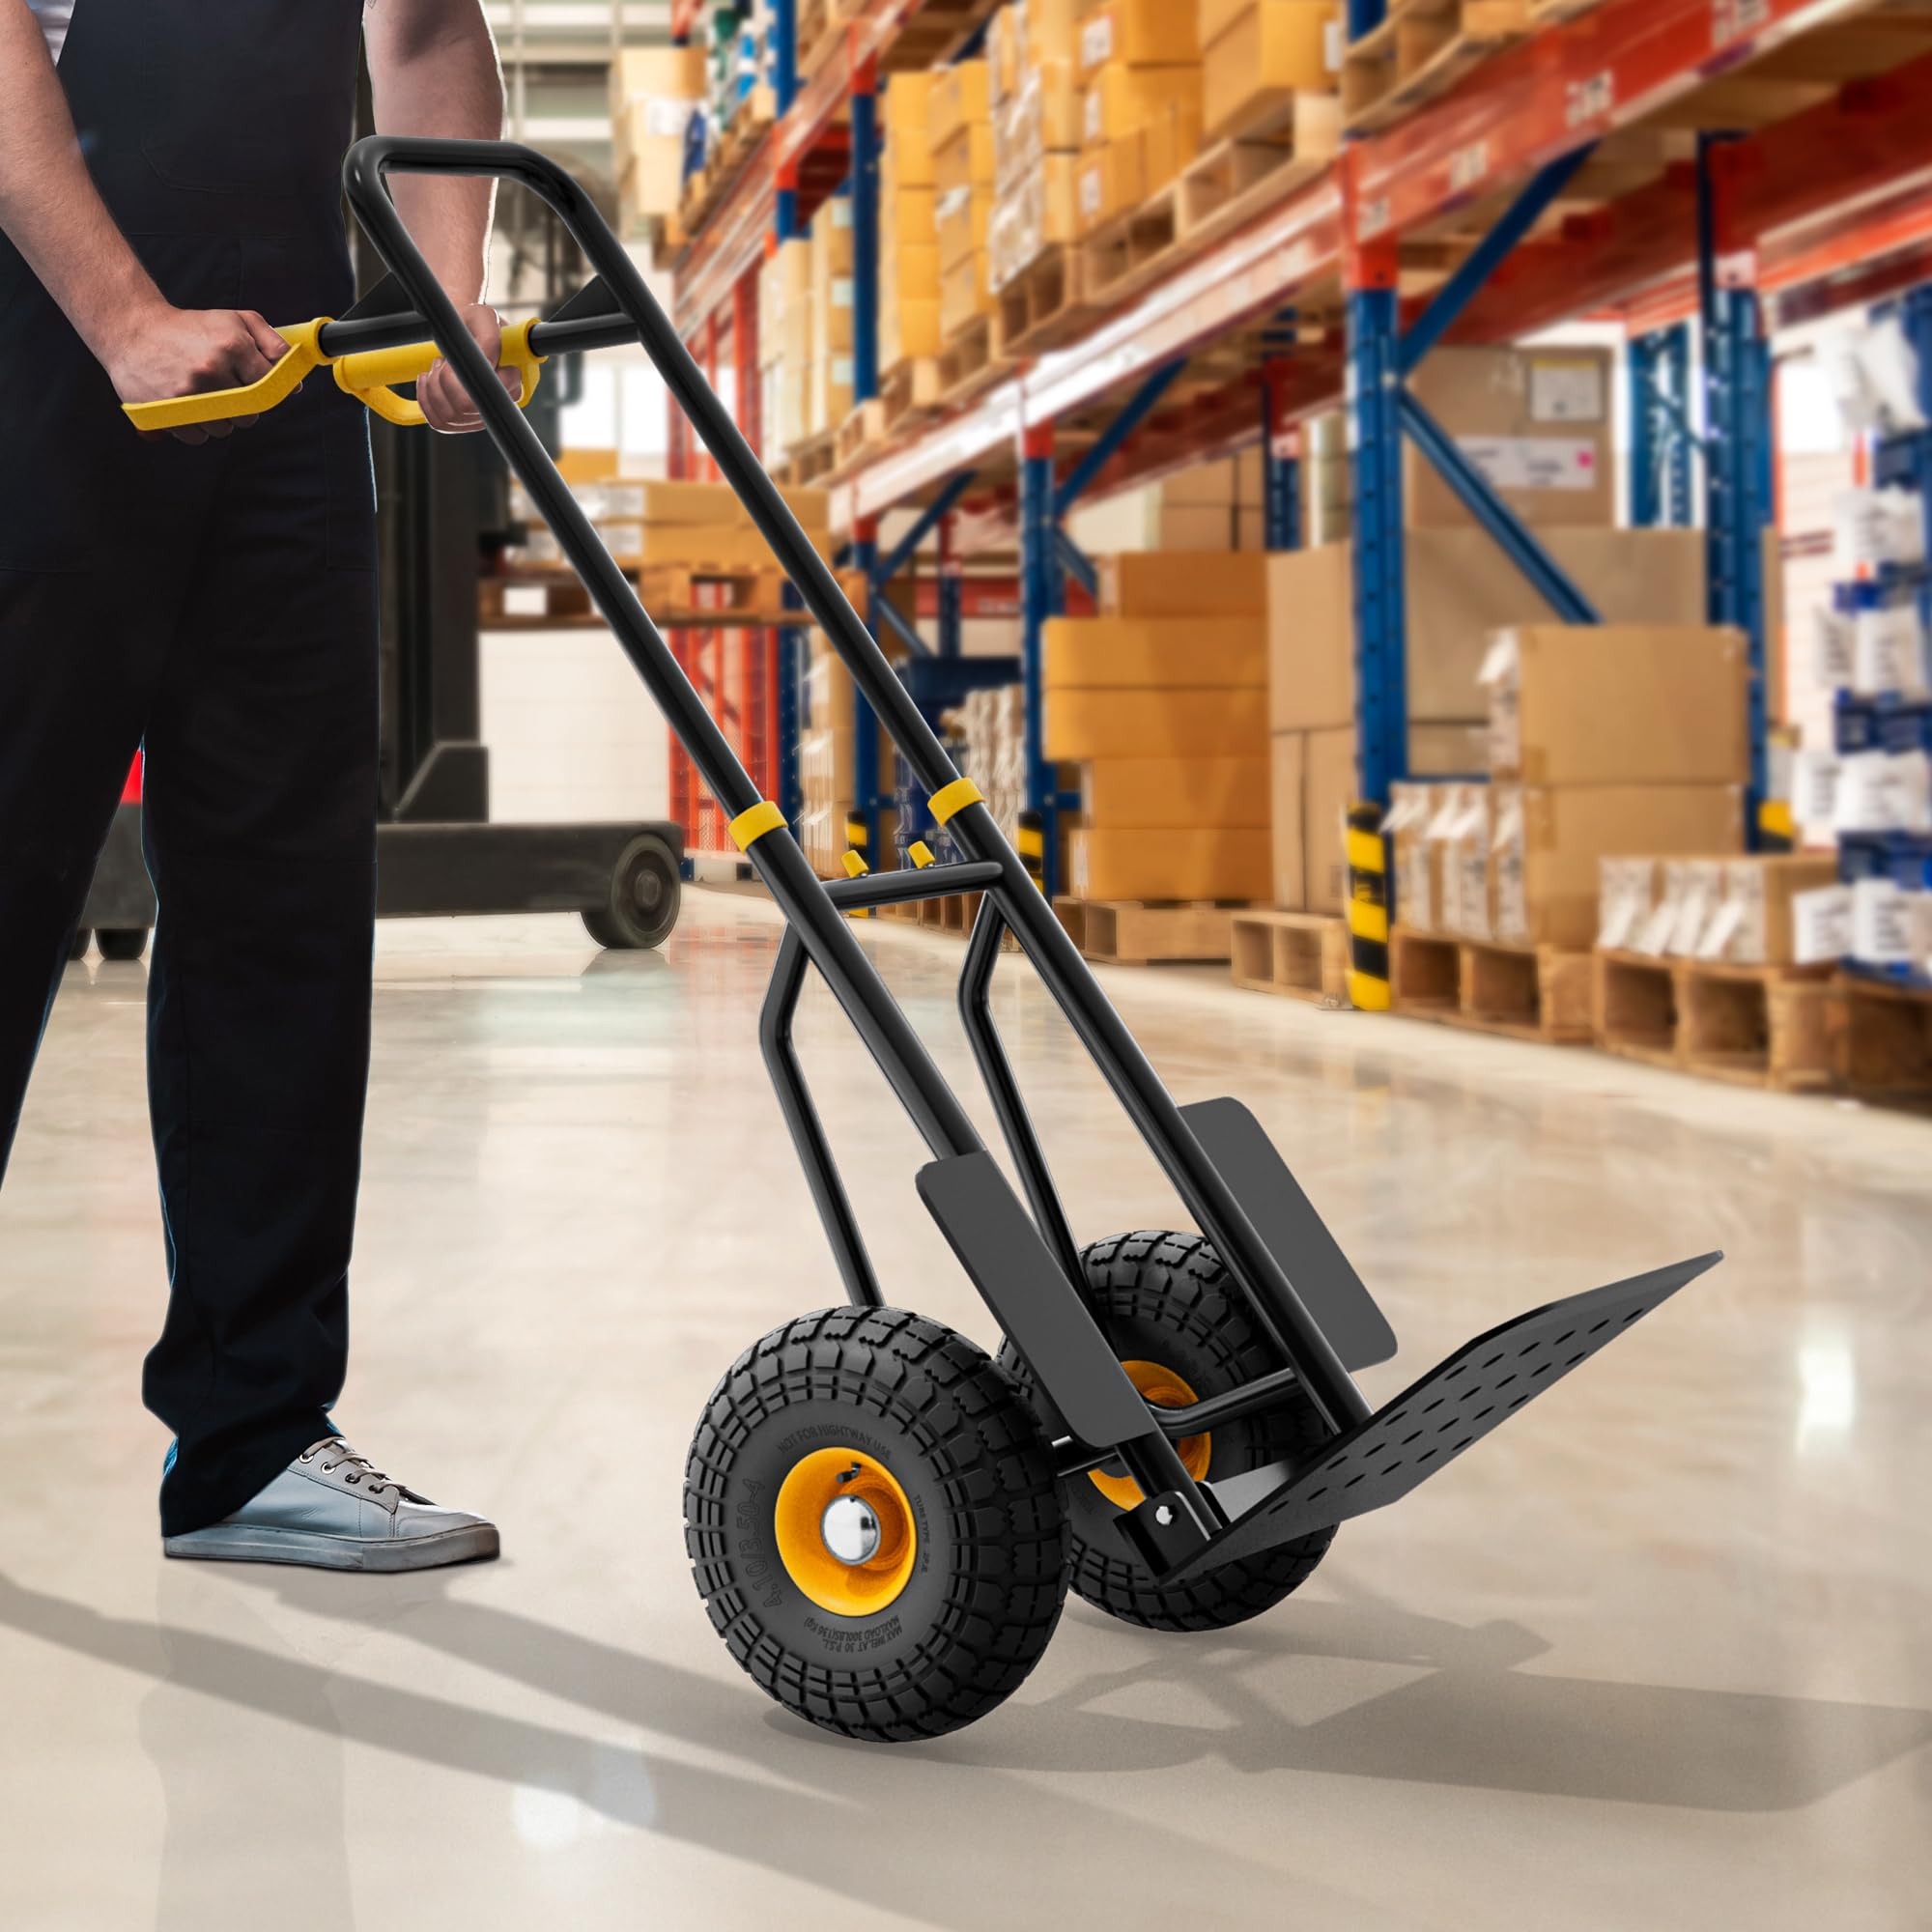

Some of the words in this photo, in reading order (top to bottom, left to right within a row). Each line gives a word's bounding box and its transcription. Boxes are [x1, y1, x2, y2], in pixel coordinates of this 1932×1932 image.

[777, 1433, 798, 1453] NOT
[796, 1425, 818, 1441] FOR
[873, 1439, 892, 1460] USE
[887, 1625, 902, 1642] MAX
